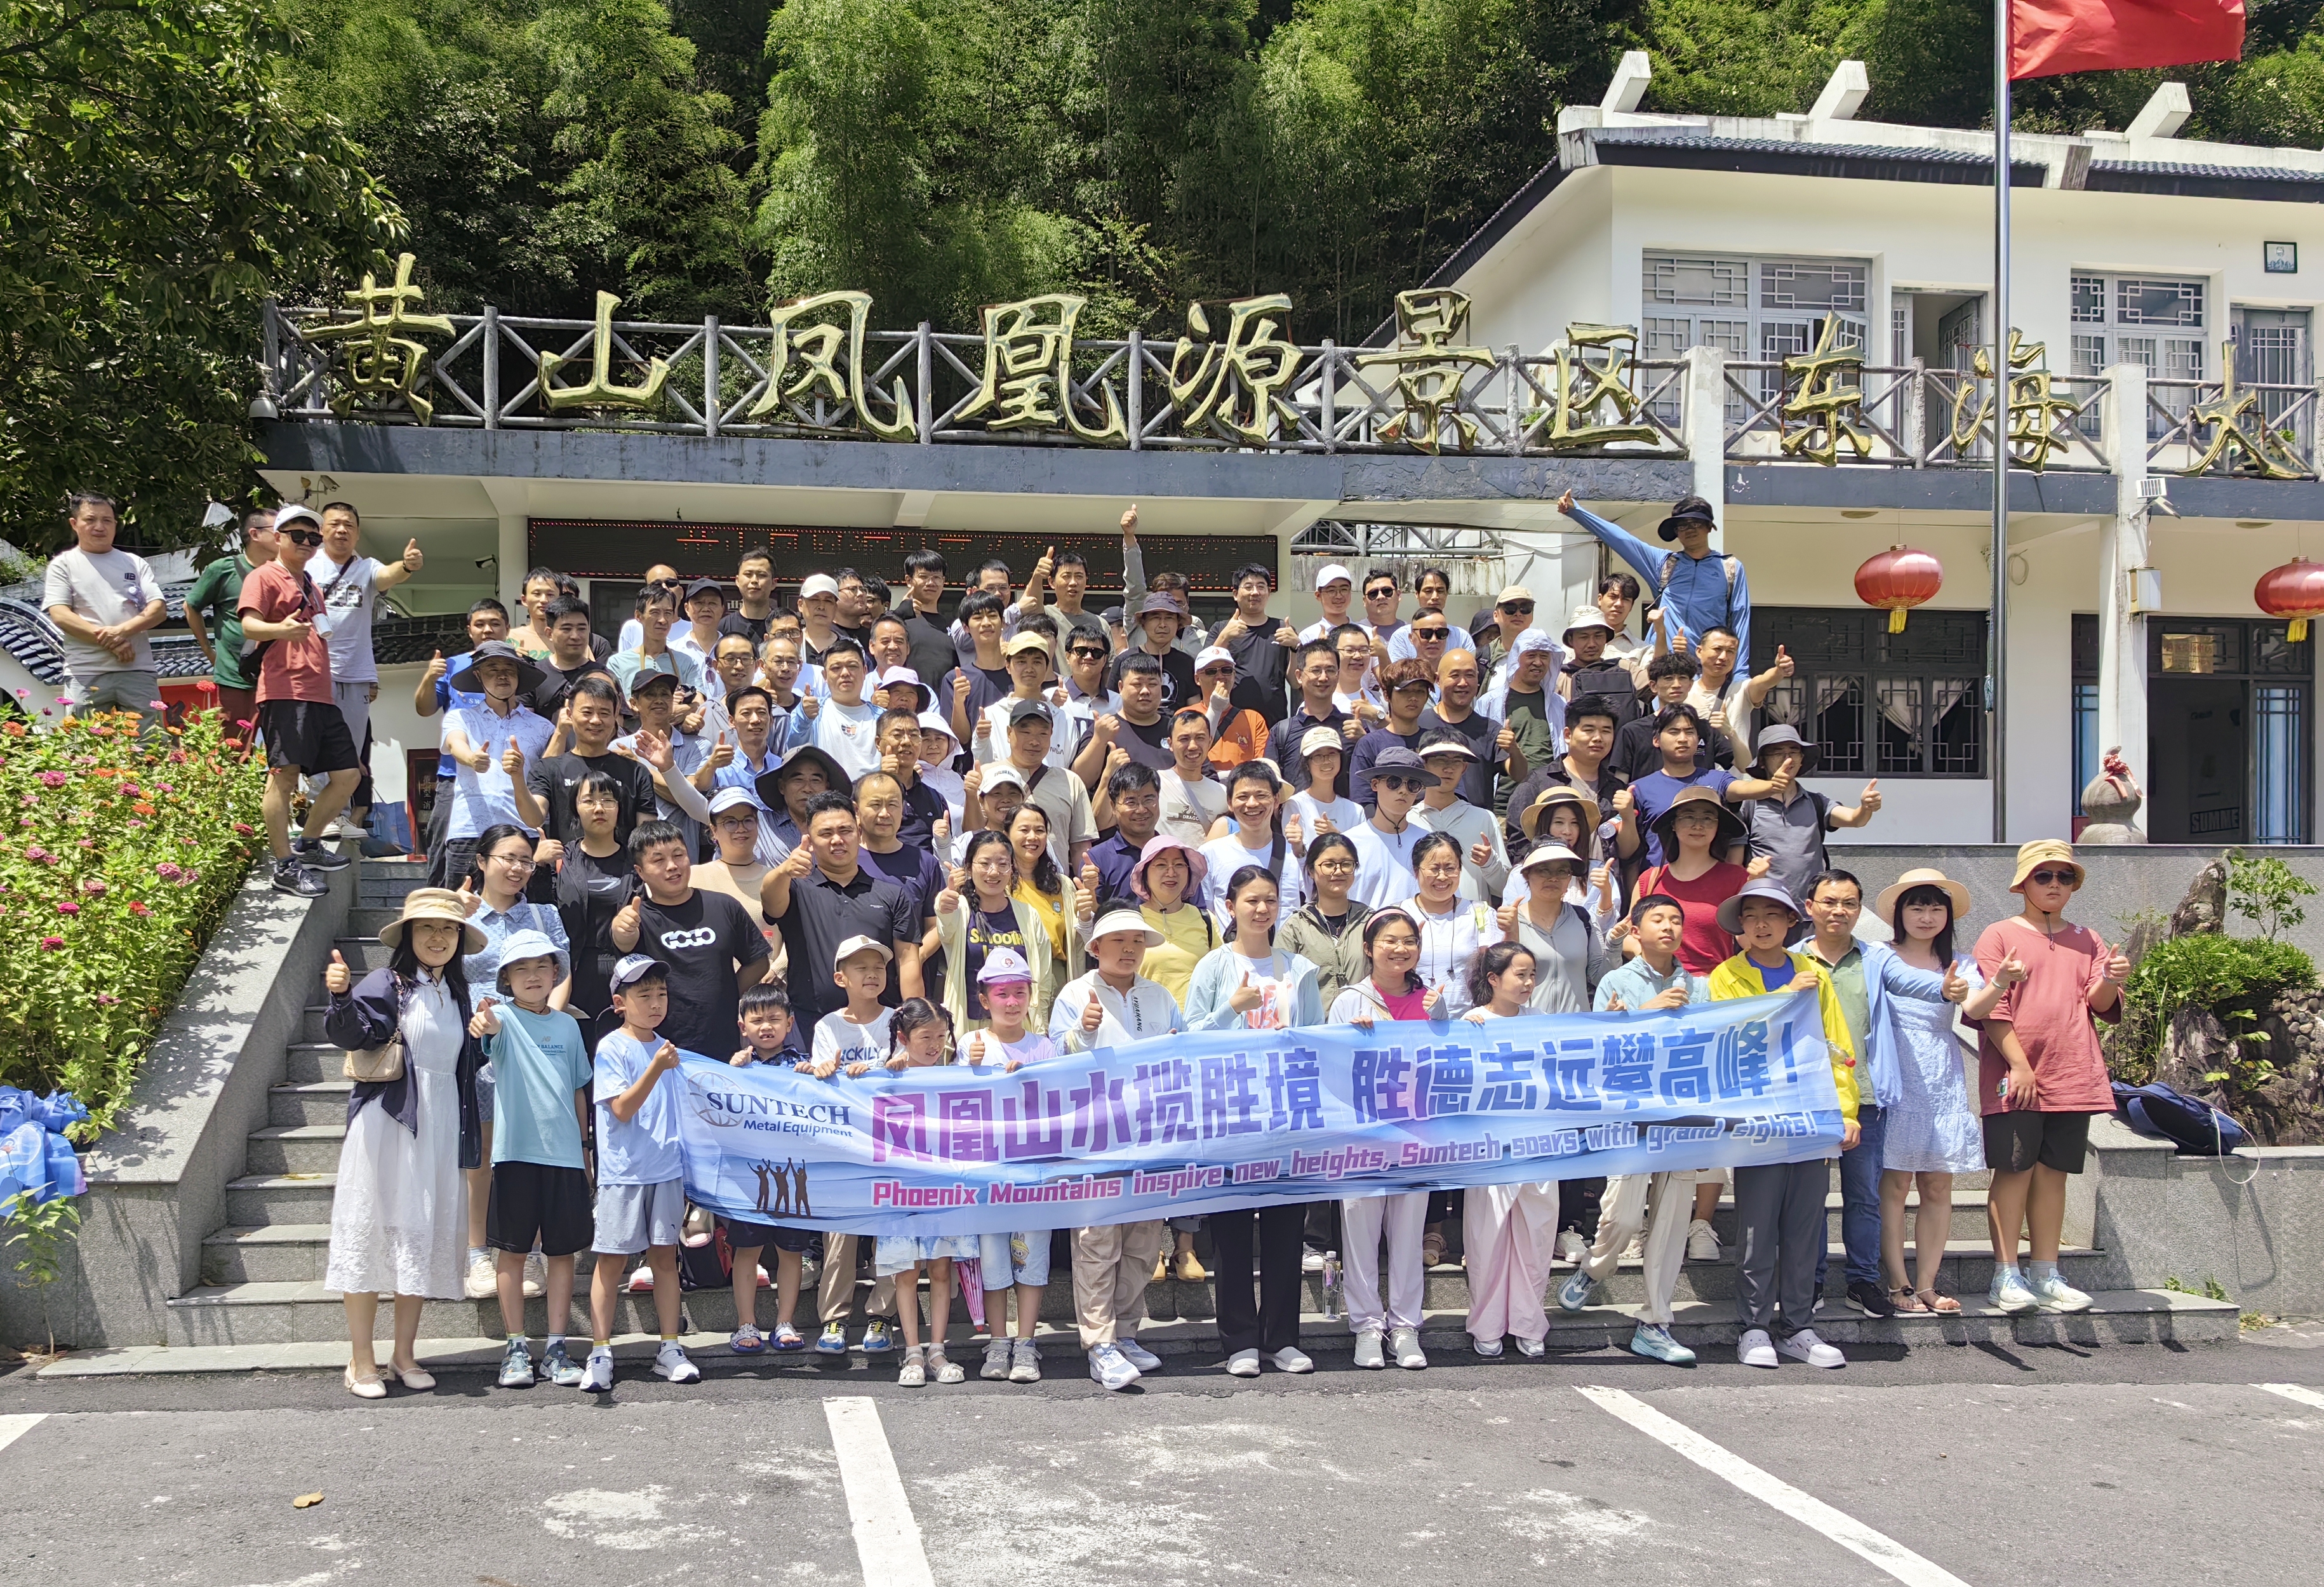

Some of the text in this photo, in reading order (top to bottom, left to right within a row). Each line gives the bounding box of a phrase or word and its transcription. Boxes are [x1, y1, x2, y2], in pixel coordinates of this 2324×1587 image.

[706, 1092, 852, 1125] SUNTECH
[872, 1021, 1796, 1163] 凤凰山水揽胜境 胜德志远攀高峰！
[744, 1120, 853, 1137] Metal Equipment
[873, 1113, 1816, 1206] Phoenix Mountains inspire new heights, Suntech soars with grand sights!
